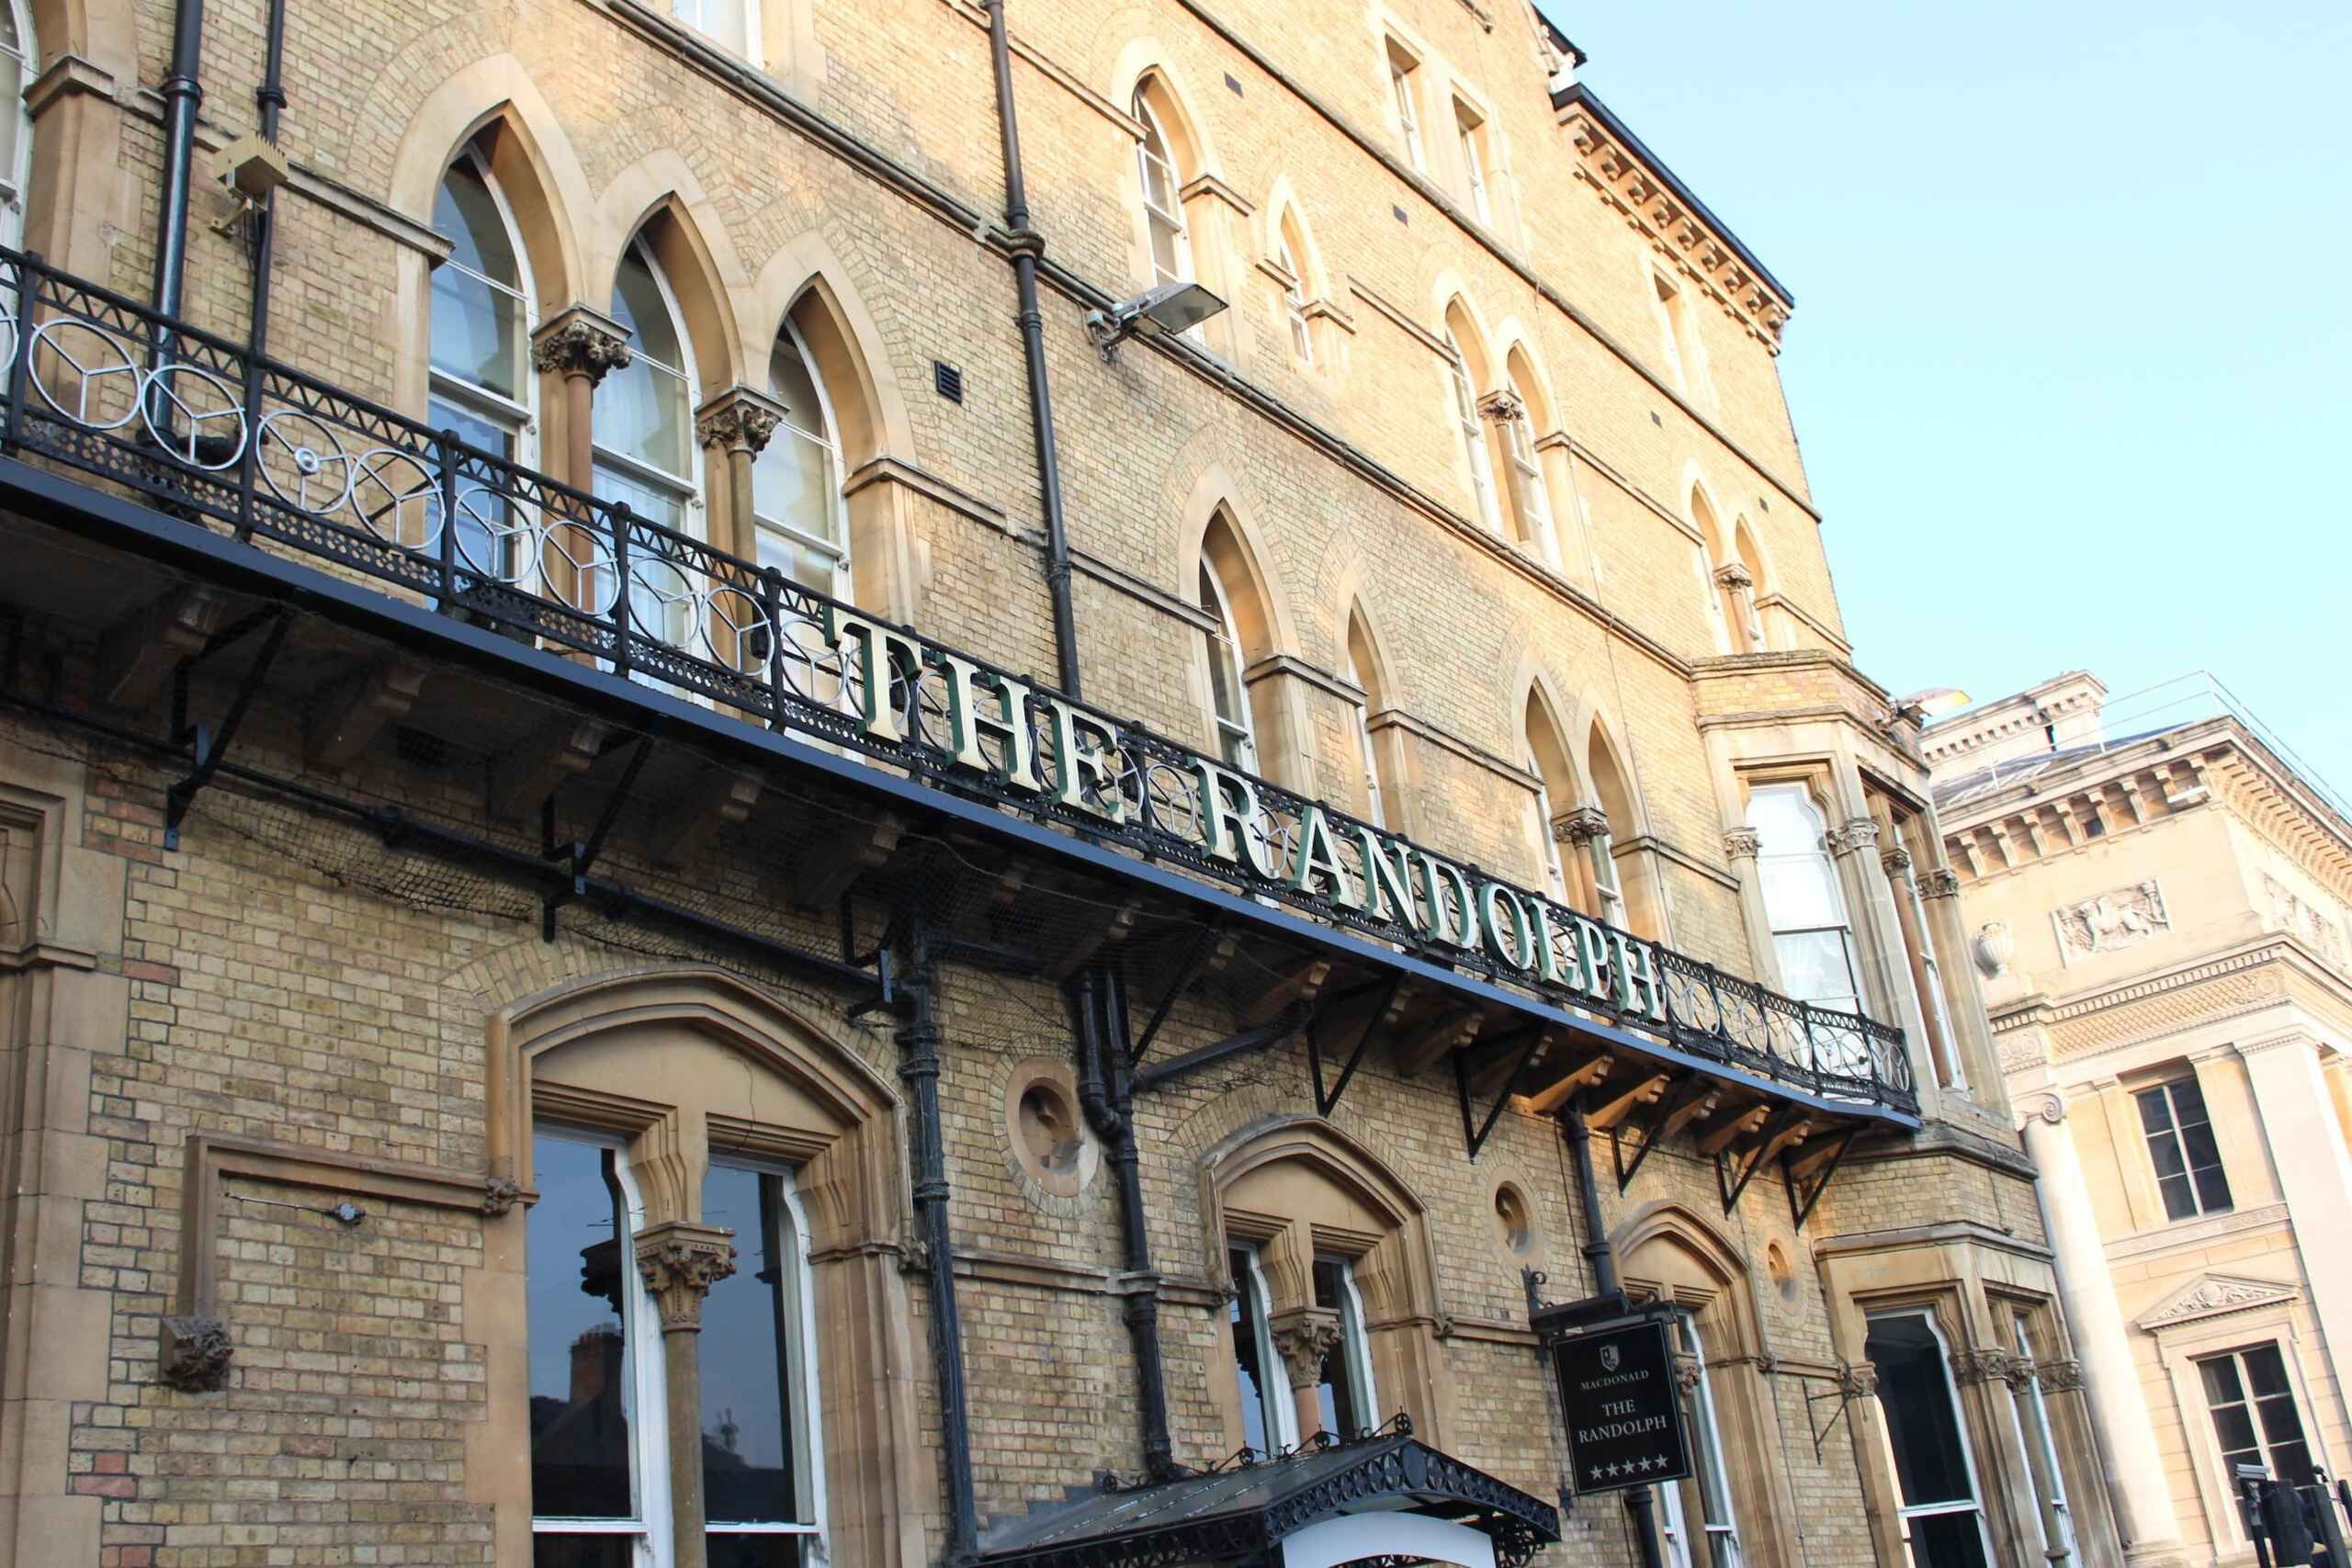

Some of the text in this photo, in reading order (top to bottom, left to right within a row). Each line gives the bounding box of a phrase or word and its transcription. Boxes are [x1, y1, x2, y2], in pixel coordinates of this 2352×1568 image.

[823, 604, 1666, 1024] THE RANDOLPH
[1580, 1370, 1649, 1391] MACDONALD
[1600, 1399, 1635, 1417] THE
[1578, 1416, 1667, 1443] RANDOLPH
